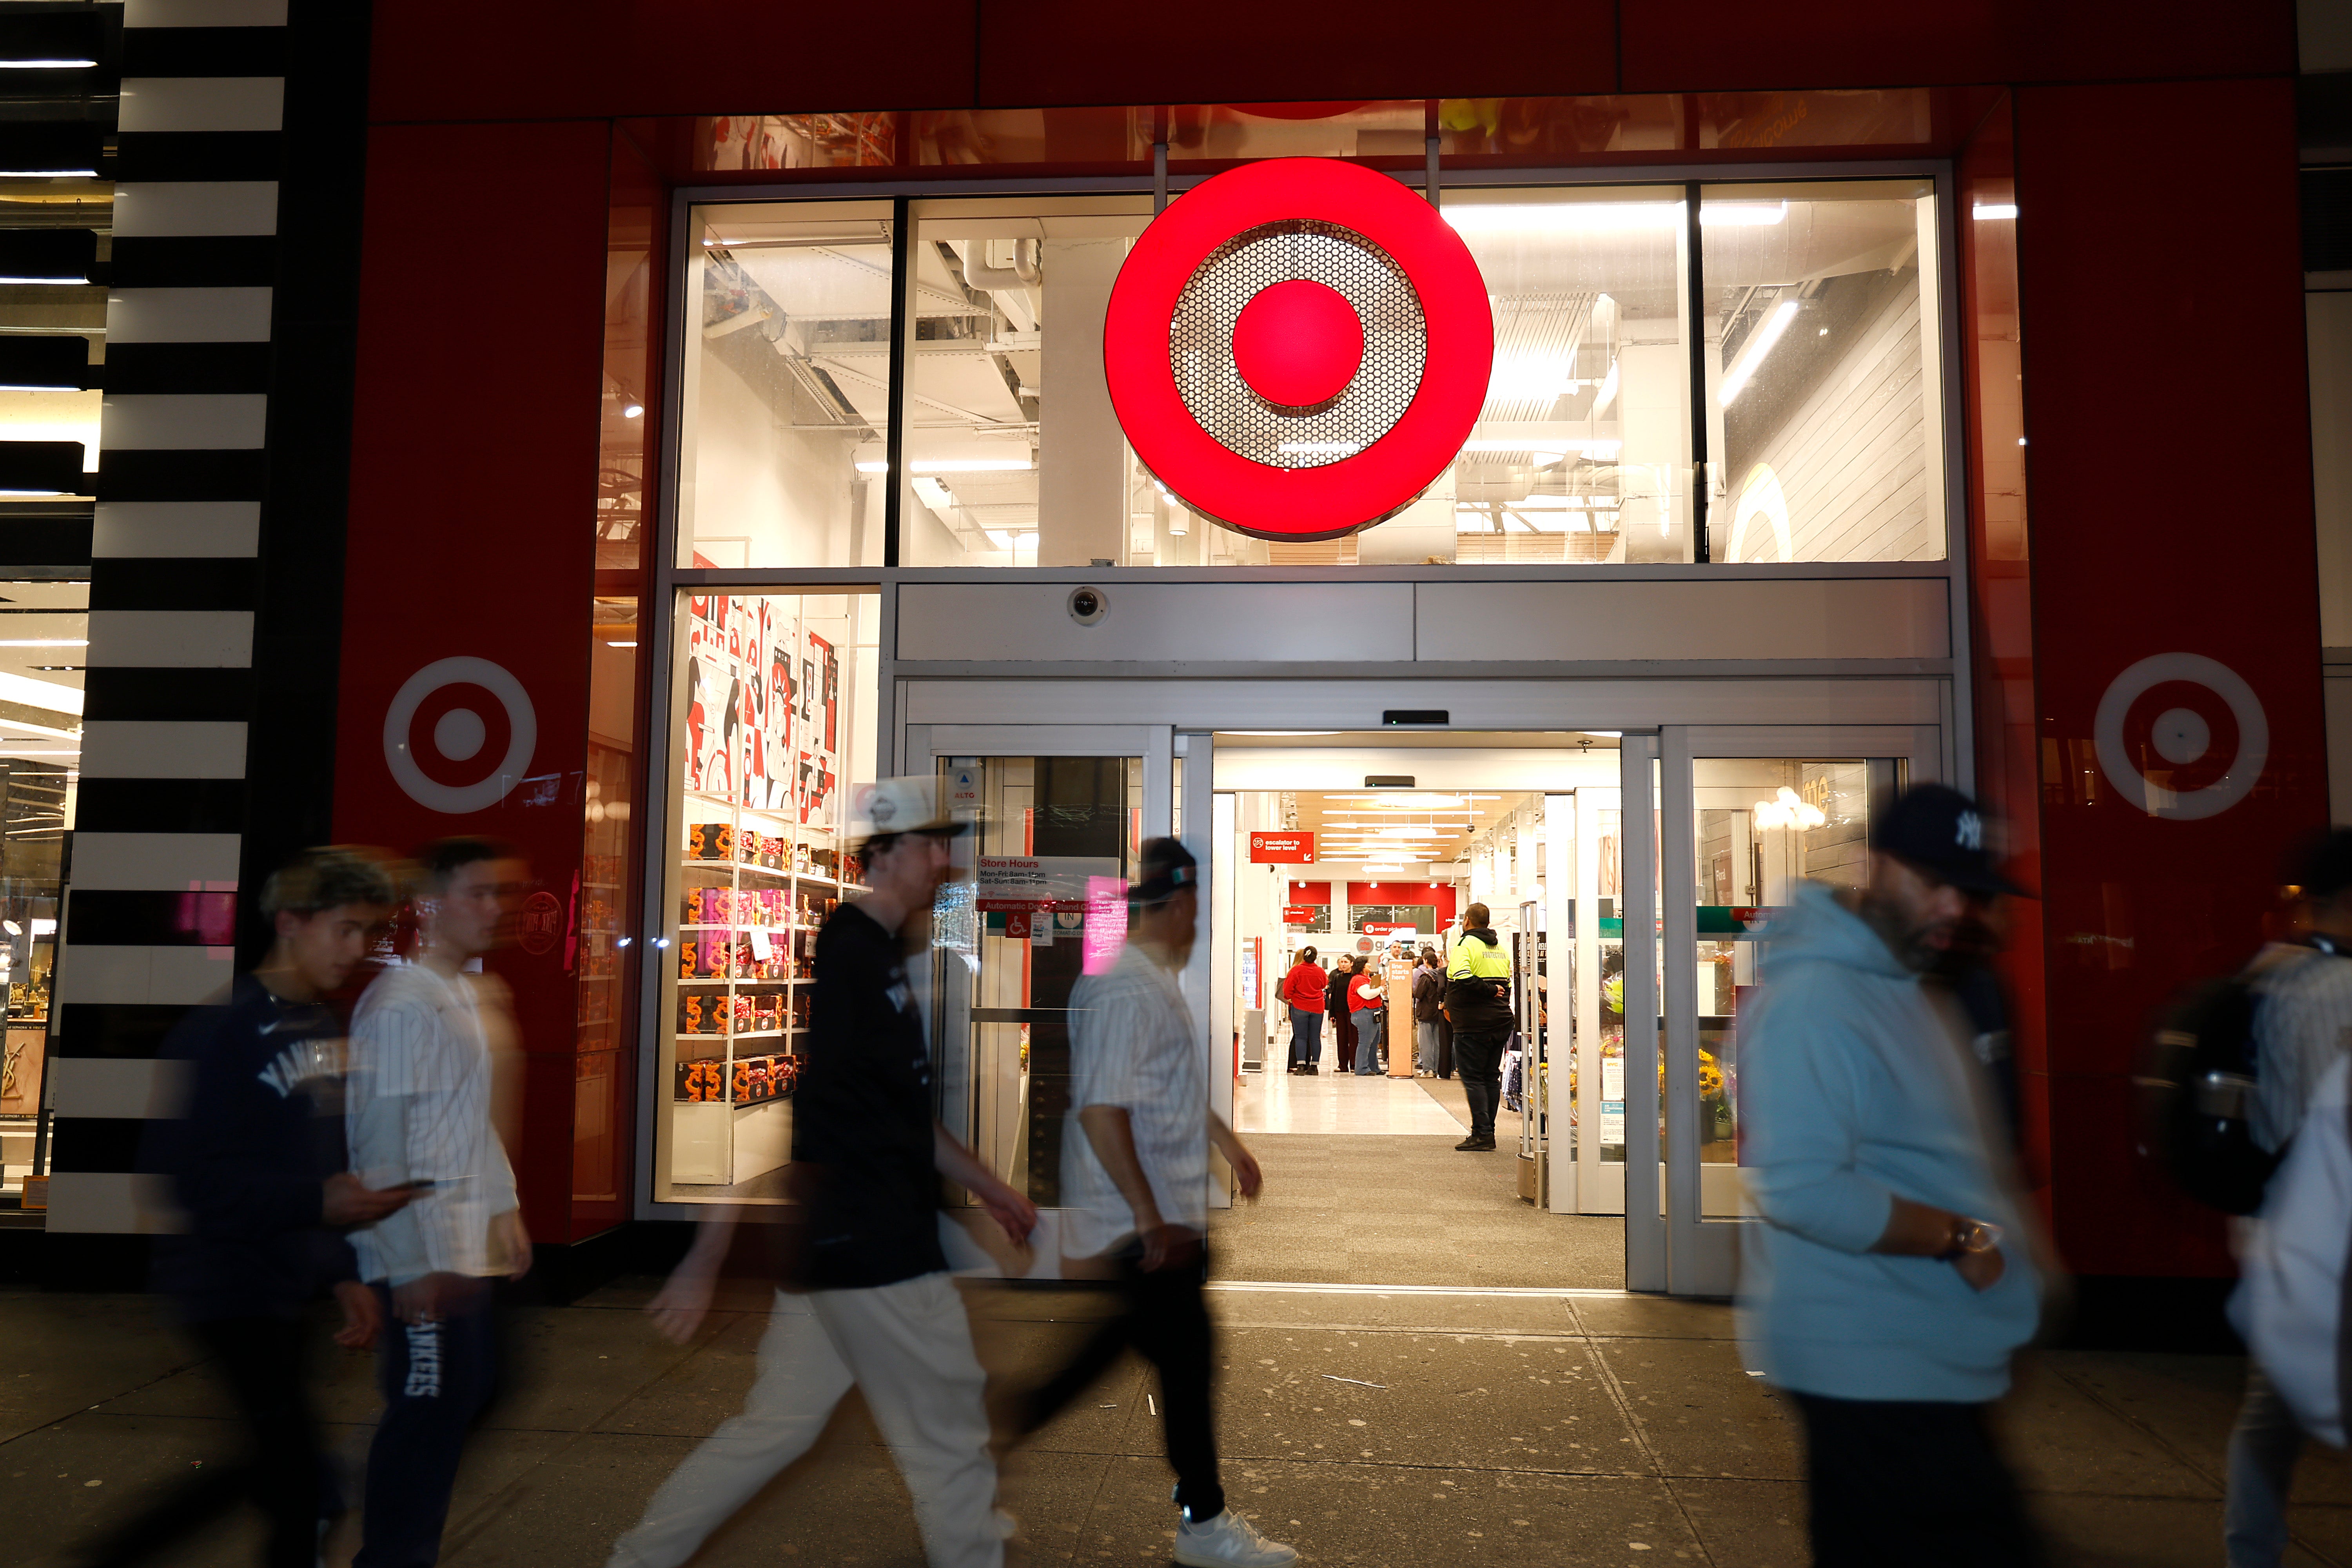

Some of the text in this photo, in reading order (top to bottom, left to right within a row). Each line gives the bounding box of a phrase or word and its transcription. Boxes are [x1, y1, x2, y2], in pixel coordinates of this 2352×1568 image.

[1955, 810, 1981, 851] NY
[980, 858, 1039, 868] Store Hours
[1716, 868, 1726, 881] Floral
[1418, 941, 1434, 951] go
